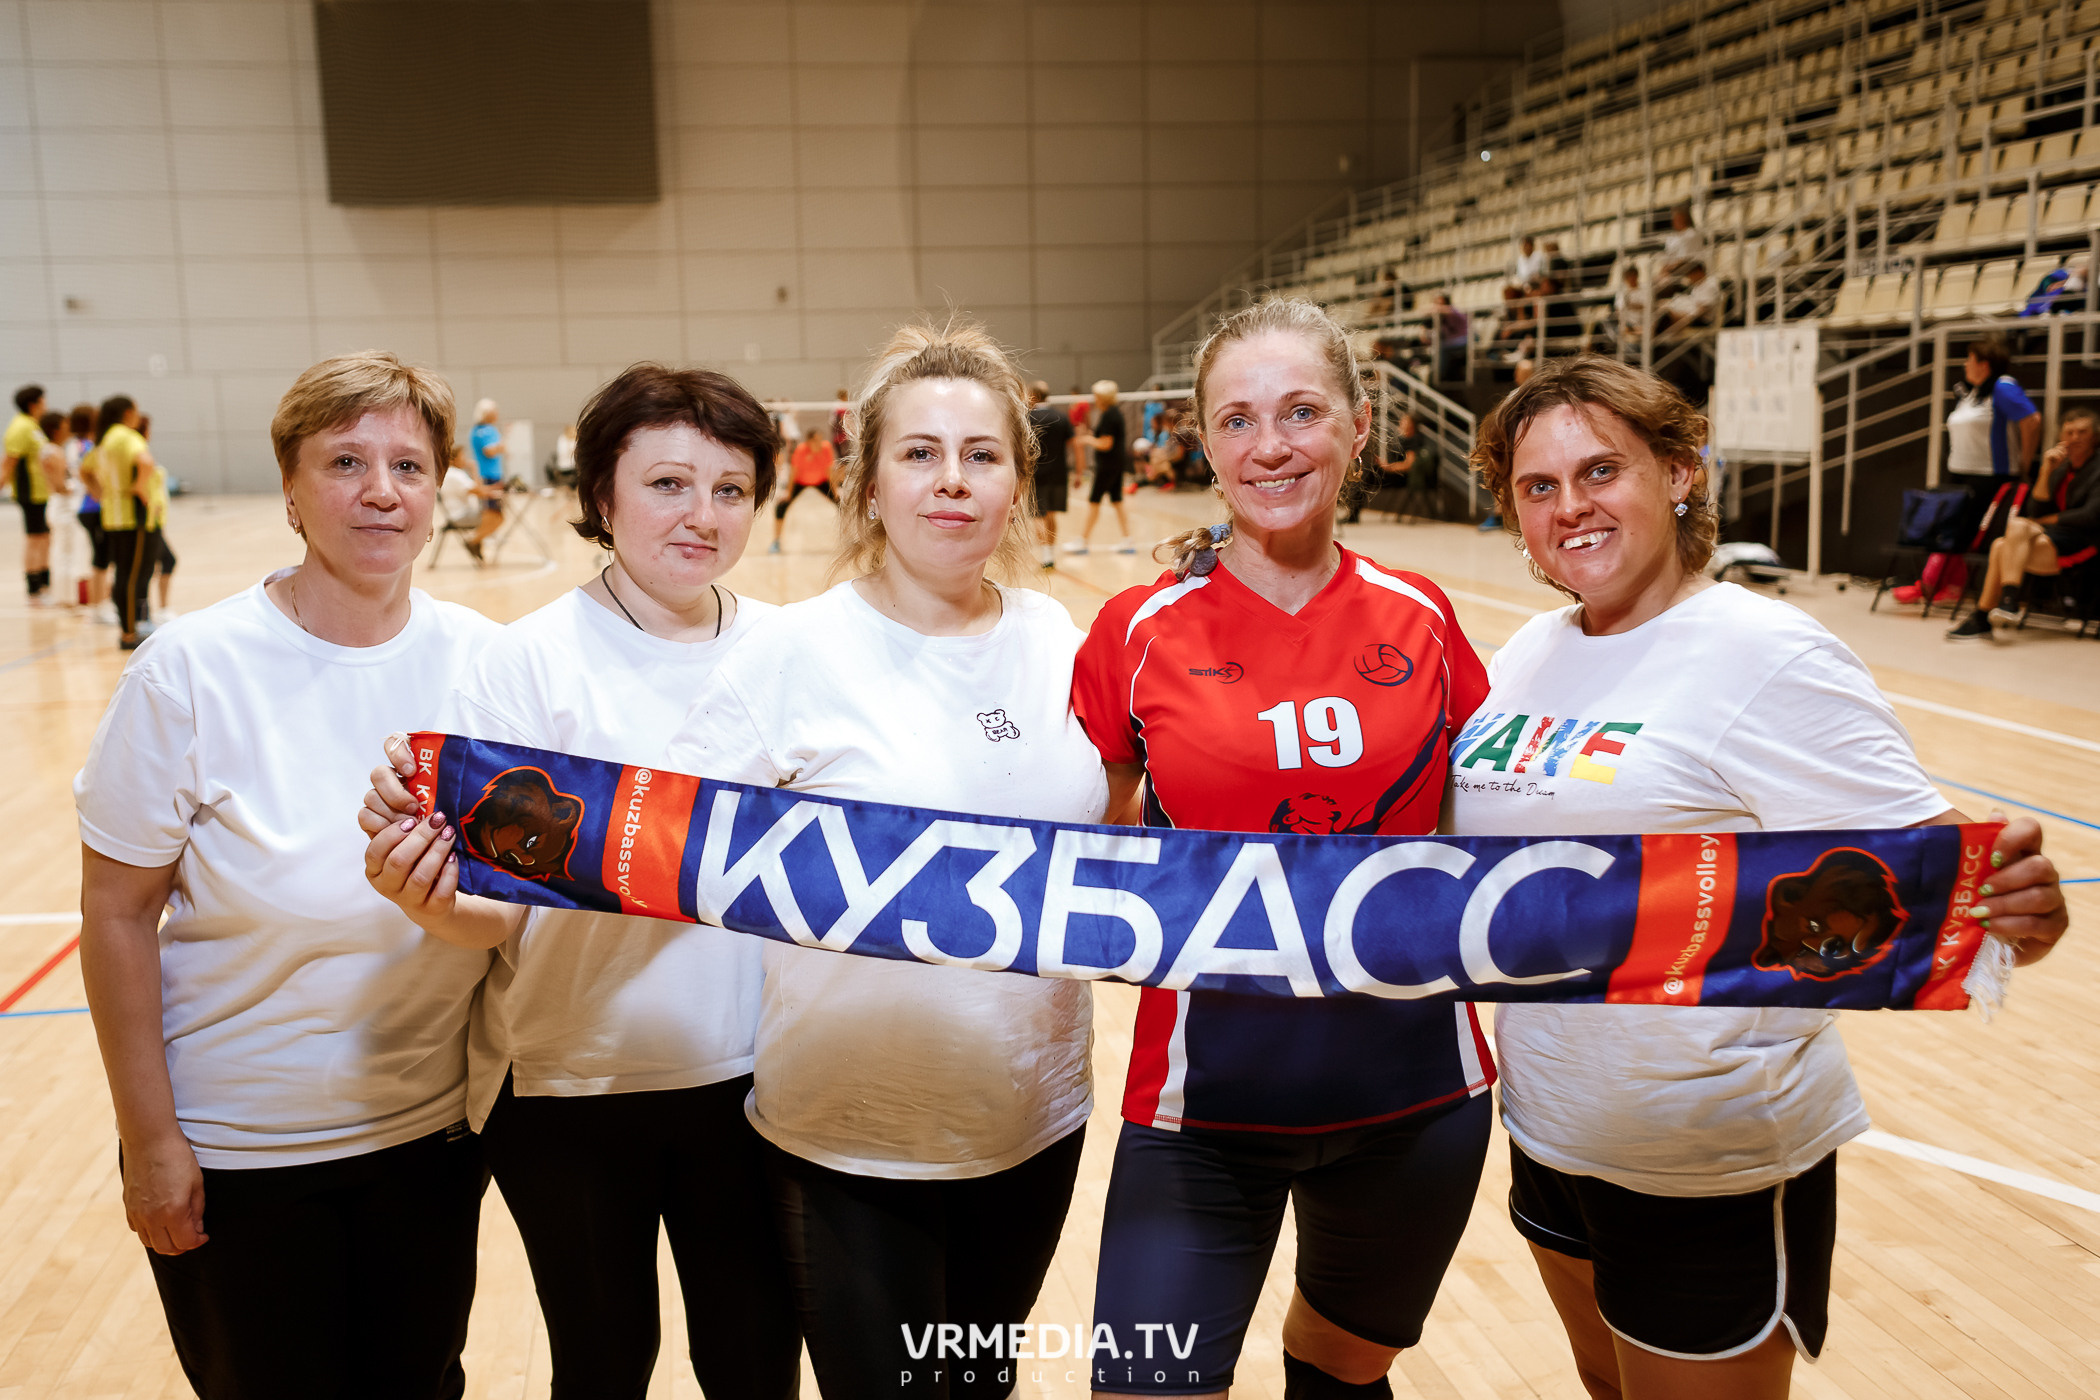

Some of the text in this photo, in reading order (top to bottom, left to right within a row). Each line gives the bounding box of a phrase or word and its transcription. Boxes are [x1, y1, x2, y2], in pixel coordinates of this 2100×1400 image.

[1257, 696, 1364, 770] 19
[1450, 774, 1470, 792] Take
[1473, 783, 1486, 792] me
[1489, 781, 1501, 791] to
[1503, 779, 1522, 793] the
[696, 789, 1616, 999] КУЗБАСС
[1663, 834, 1721, 996] @kuzbassvolley
[1941, 844, 1984, 947] КУЗБАСС
